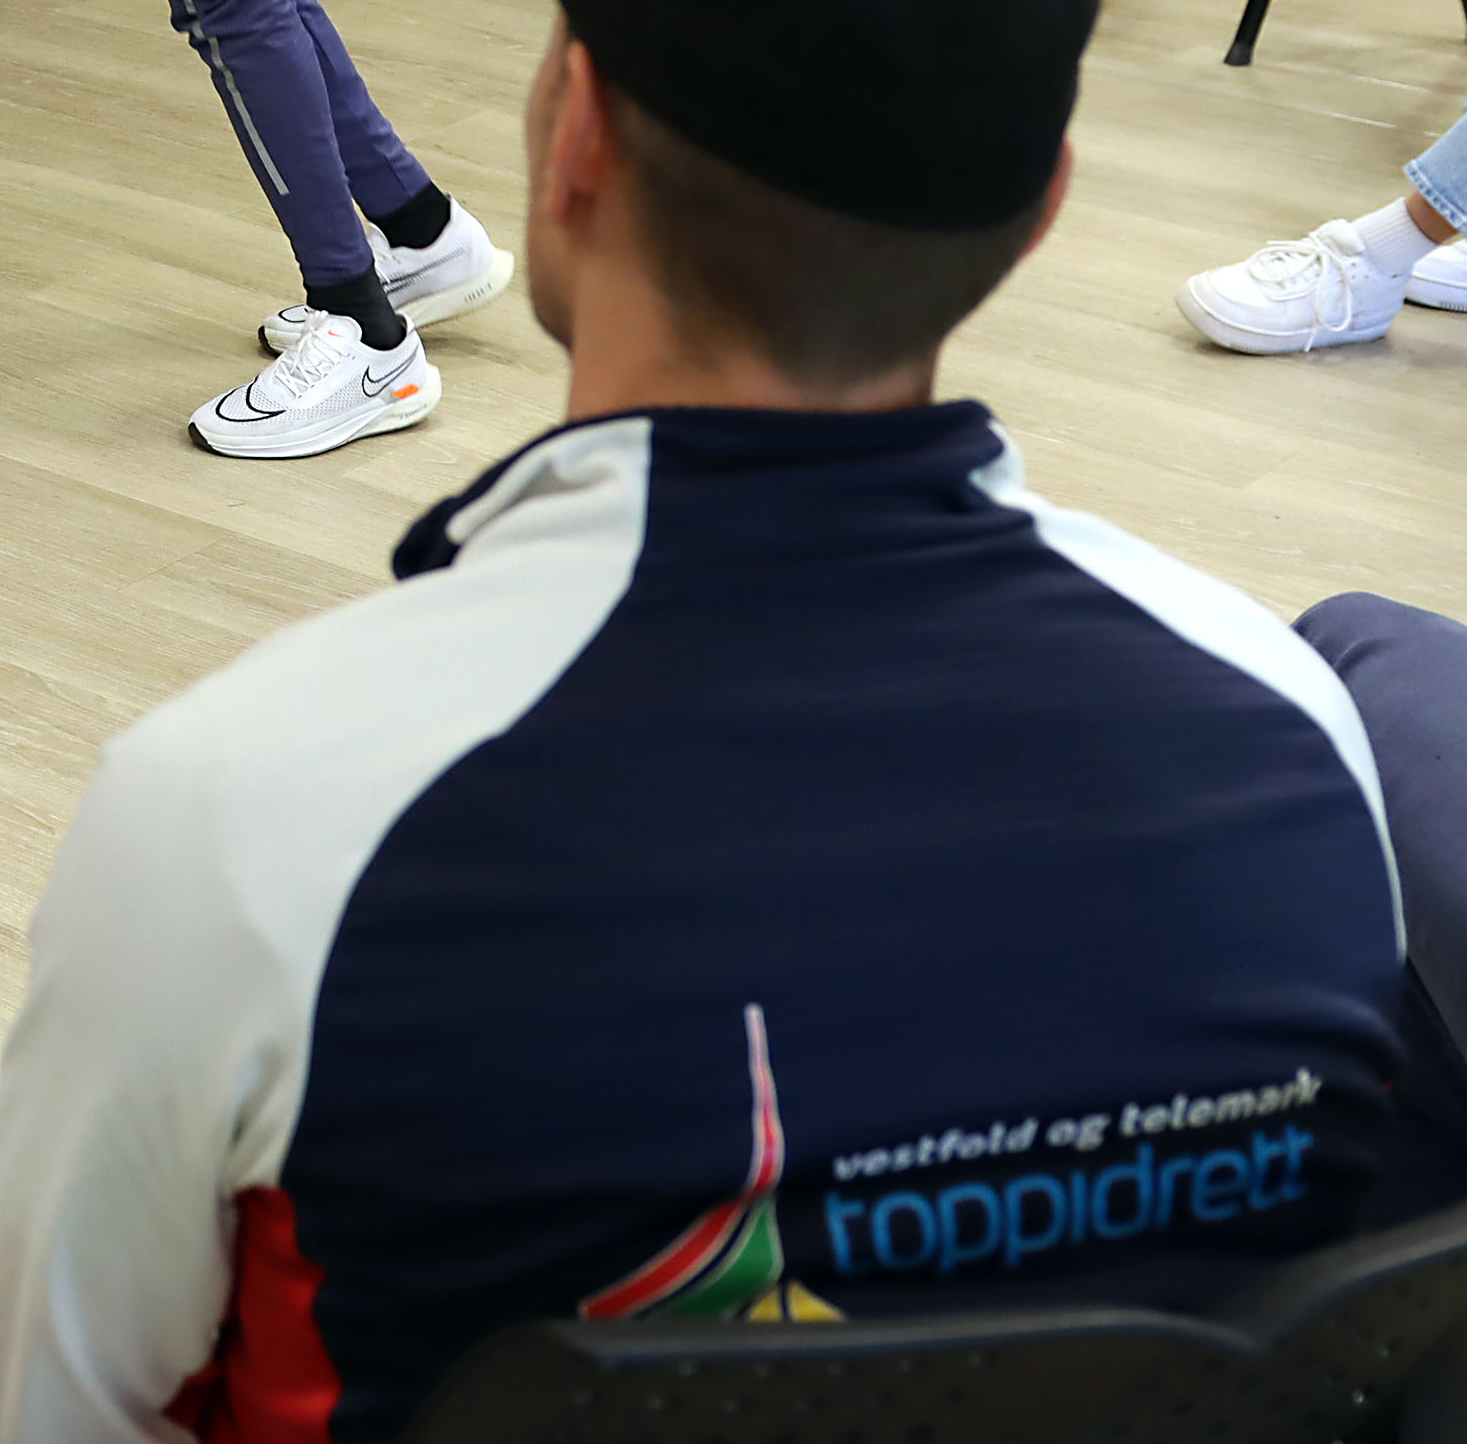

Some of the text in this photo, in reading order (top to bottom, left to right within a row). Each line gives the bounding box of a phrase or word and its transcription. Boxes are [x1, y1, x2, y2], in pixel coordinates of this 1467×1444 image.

[833, 1065, 1323, 1181] vestfold og telemark
[824, 1123, 1314, 1273] toppidrett
